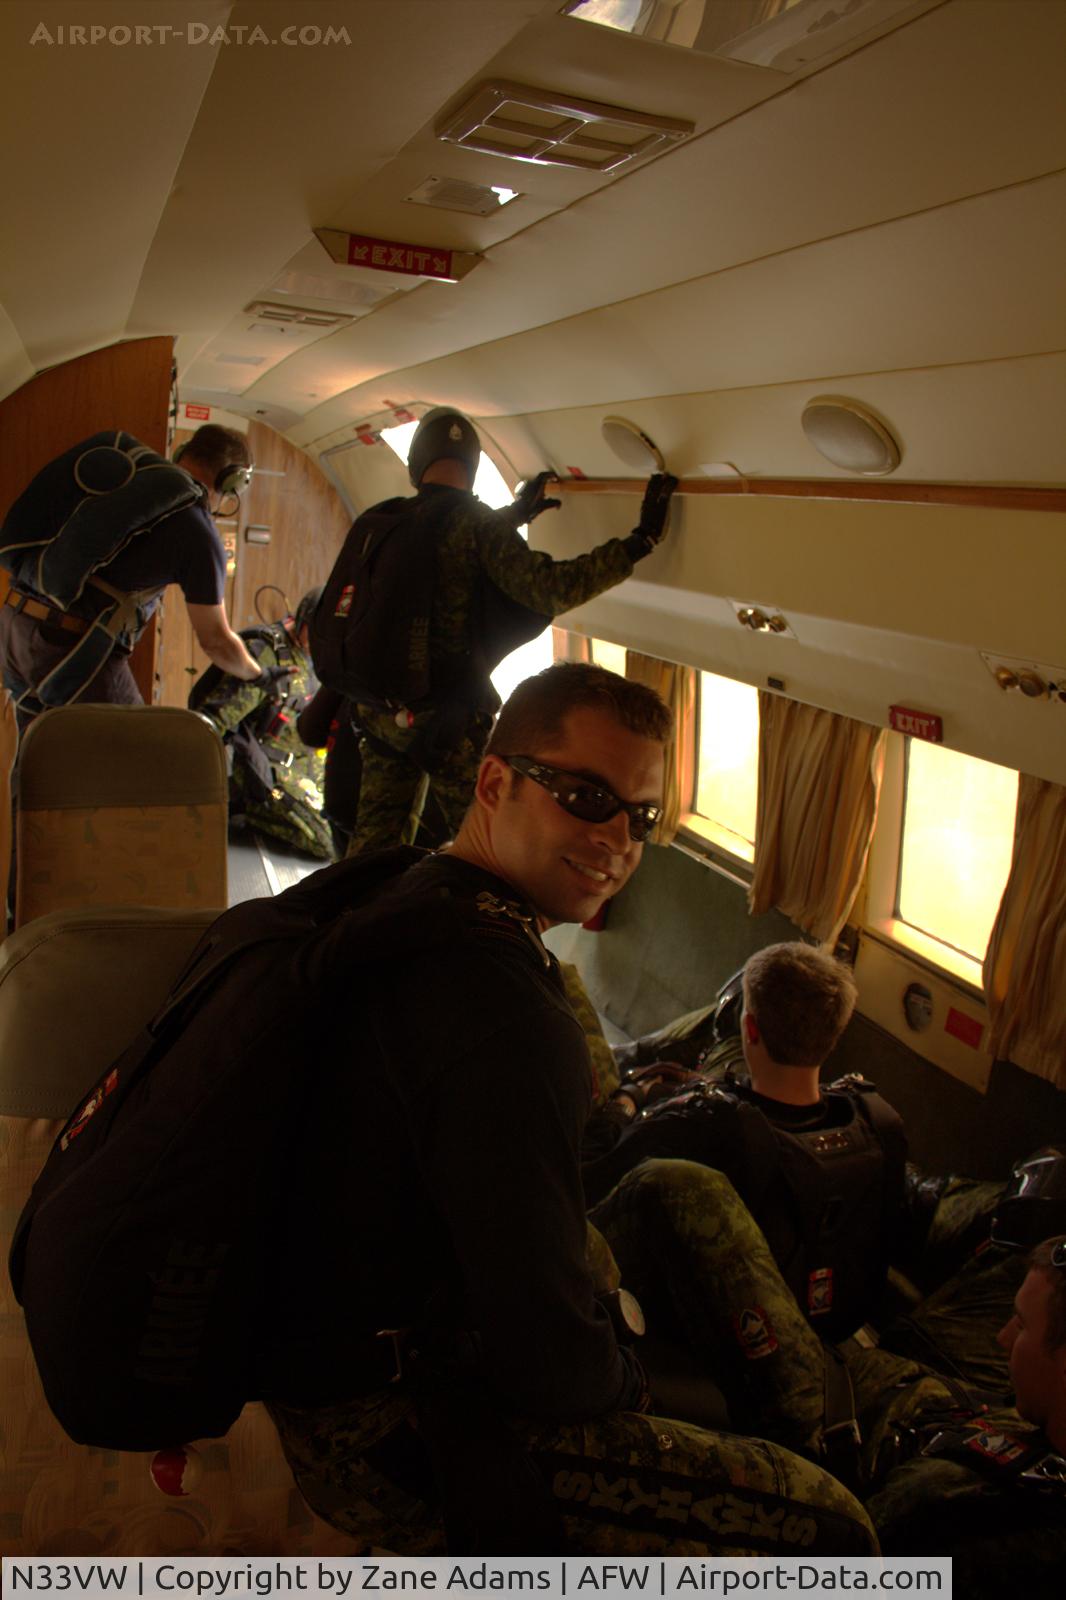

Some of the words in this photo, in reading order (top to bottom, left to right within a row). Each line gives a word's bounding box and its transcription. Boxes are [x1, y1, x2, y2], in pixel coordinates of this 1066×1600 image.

[371, 245, 432, 271] EXIT
[895, 712, 930, 737] EXIT
[552, 1469, 819, 1547] SKYHAWKS
